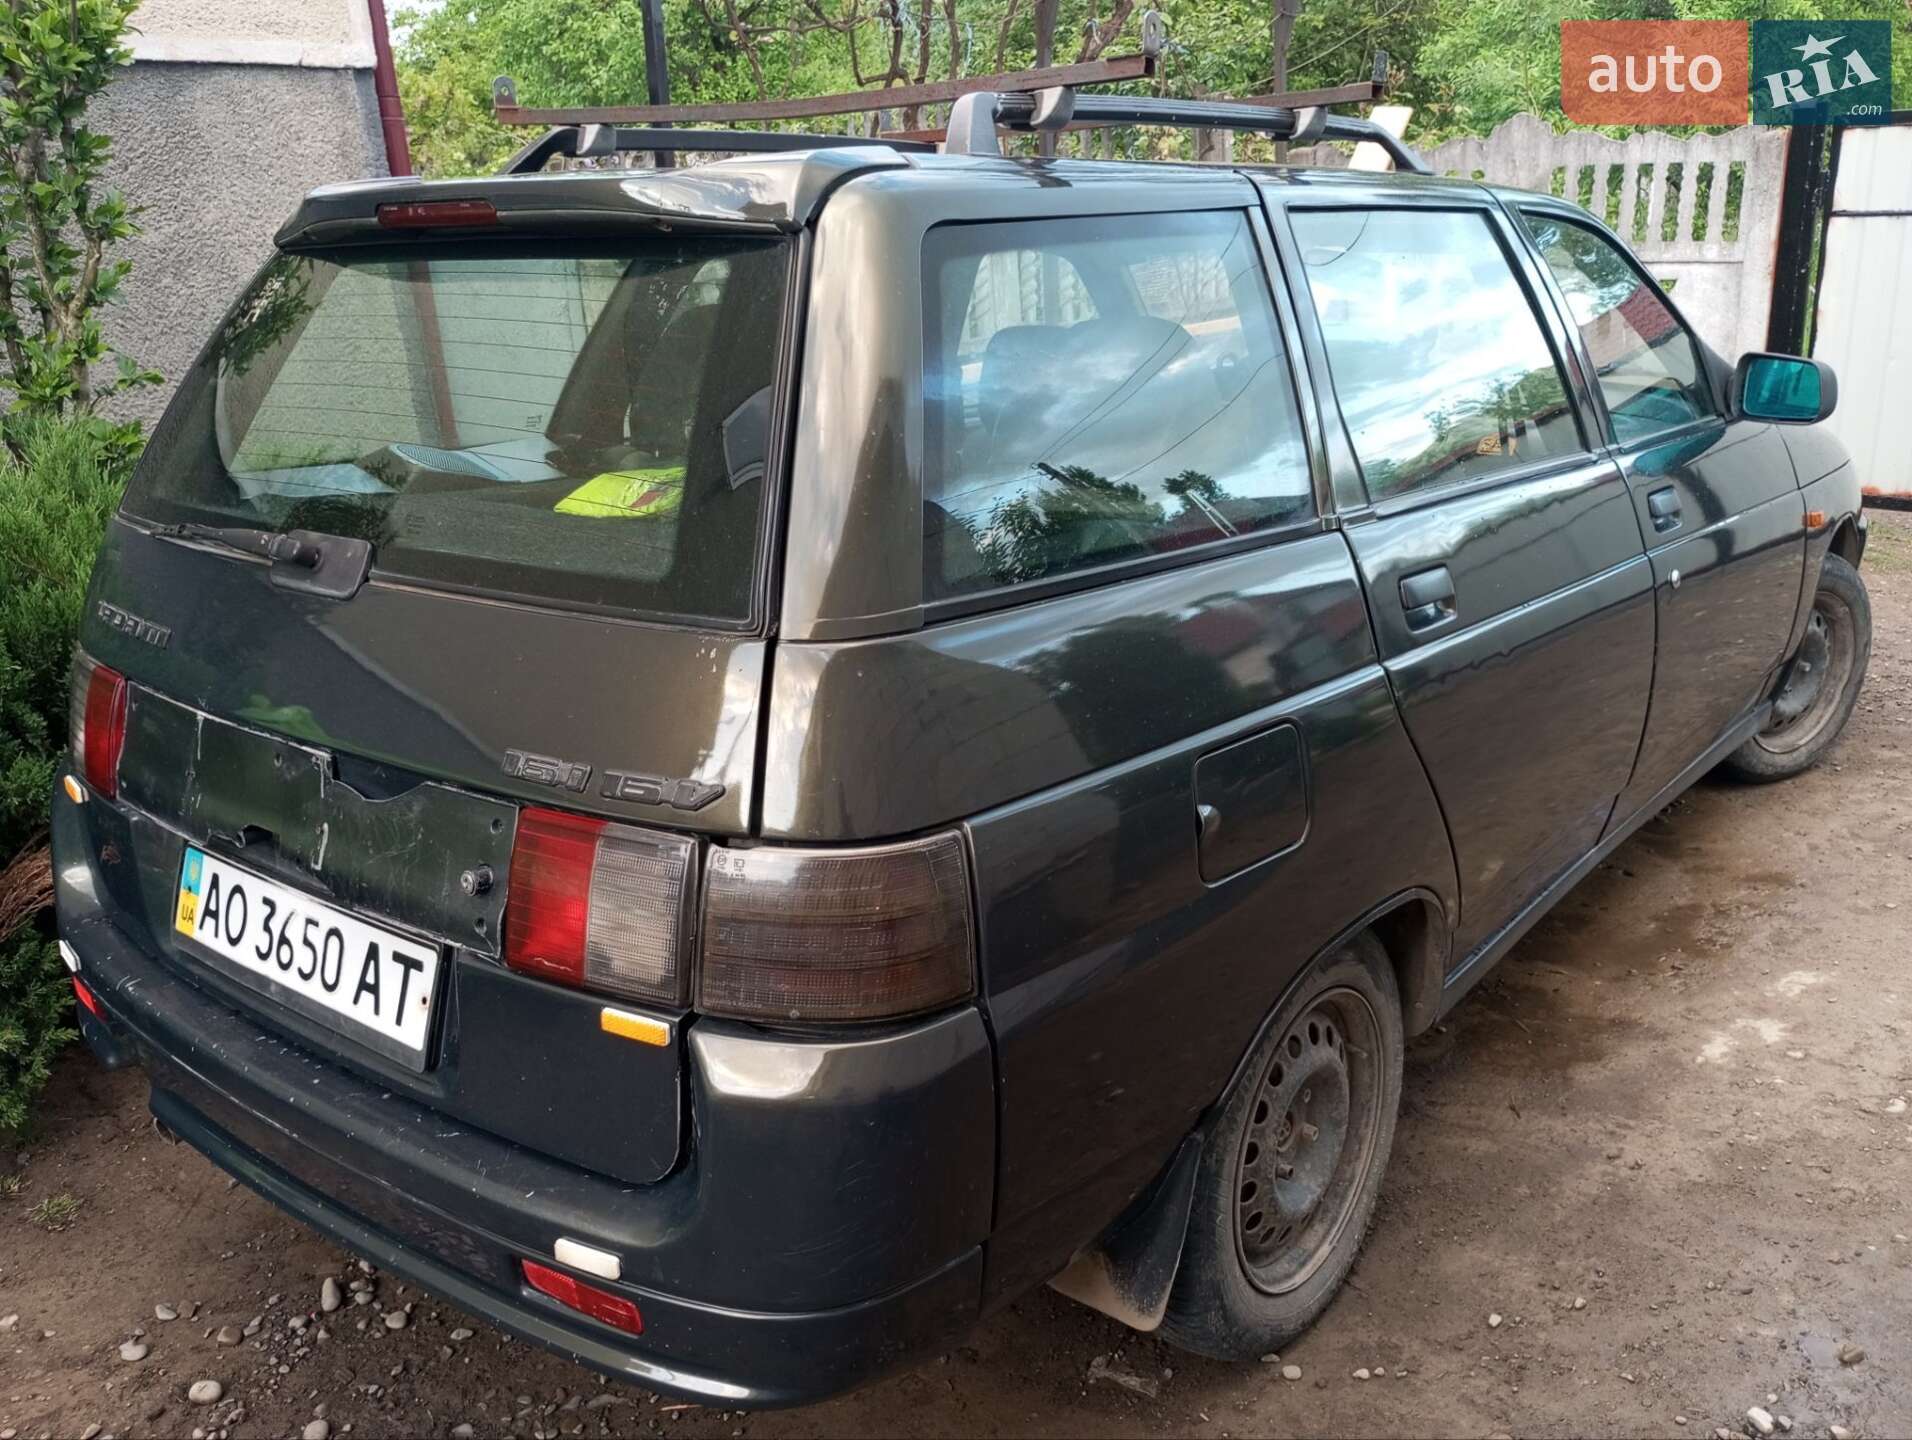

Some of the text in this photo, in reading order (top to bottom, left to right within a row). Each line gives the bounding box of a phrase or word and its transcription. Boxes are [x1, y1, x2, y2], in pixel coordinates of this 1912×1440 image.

[179, 903, 195, 926] UA
[199, 872, 425, 1027] AO 3650 AT
